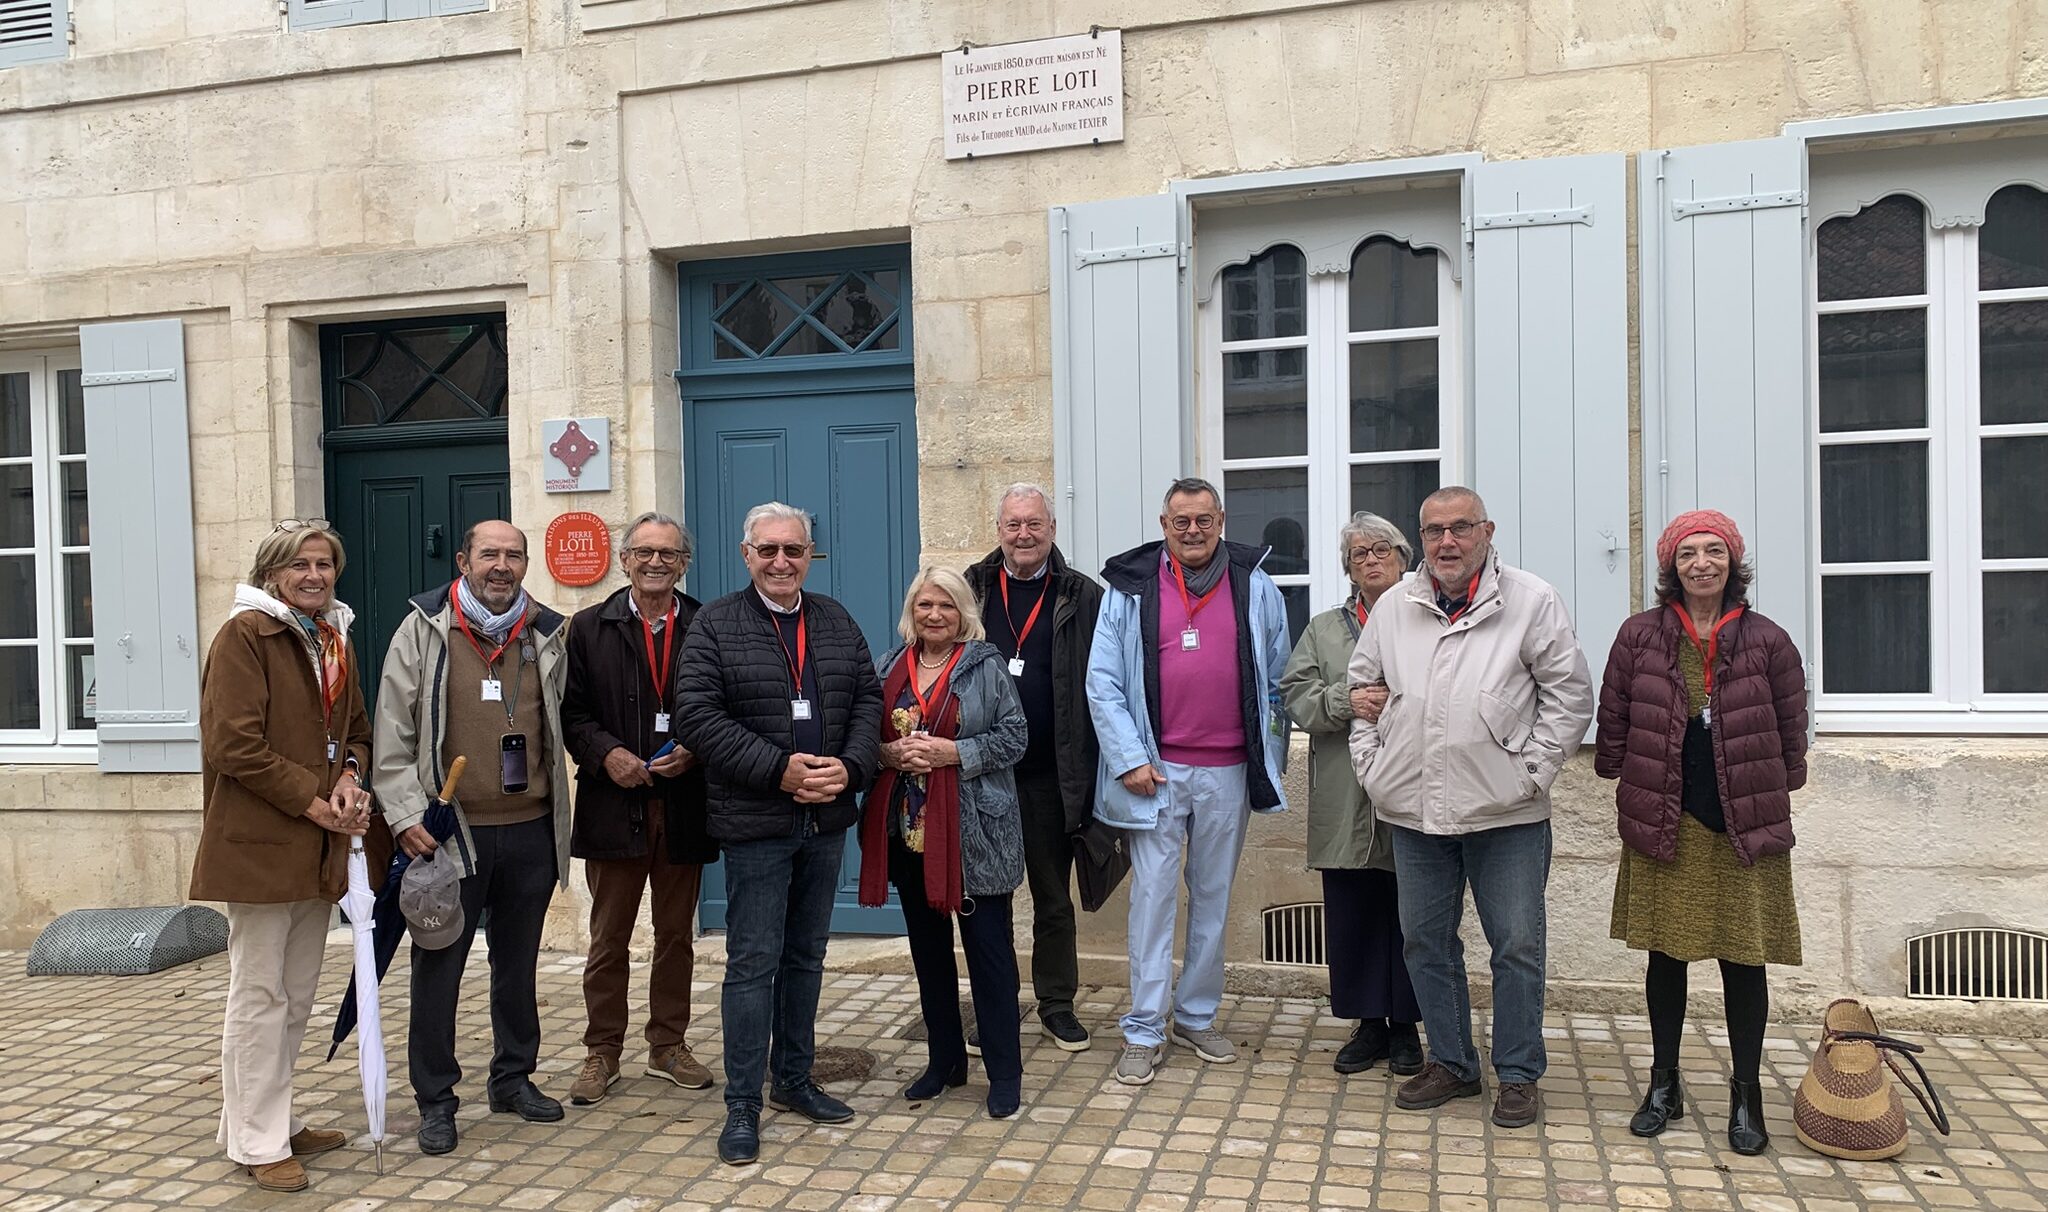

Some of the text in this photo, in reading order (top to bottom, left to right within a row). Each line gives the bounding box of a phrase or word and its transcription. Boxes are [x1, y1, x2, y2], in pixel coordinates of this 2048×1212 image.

[975, 62, 1003, 73] JANVIER
[1025, 58, 1033, 66] EN
[1035, 56, 1054, 65] CETTE
[1057, 53, 1080, 63] MAISON
[1082, 51, 1094, 59] EST
[967, 69, 1097, 102] PIERRE LOTI
[953, 110, 988, 124] MARIN
[1006, 102, 1058, 118] ÉCRIVAIN
[1062, 96, 1114, 111] FRANÇAIS
[956, 133, 969, 144] Fils
[971, 131, 980, 141] de
[1014, 125, 1035, 136] VIAUD
[1036, 126, 1043, 134] et
[1043, 124, 1051, 133] de
[1053, 122, 1077, 132] NADINE
[1079, 116, 1108, 129] TEXIER
[547, 515, 567, 547] MAISONS
[580, 514, 608, 546] ILLUSTRES
[559, 538, 594, 551] LOTI
[422, 915, 441, 928] NY
